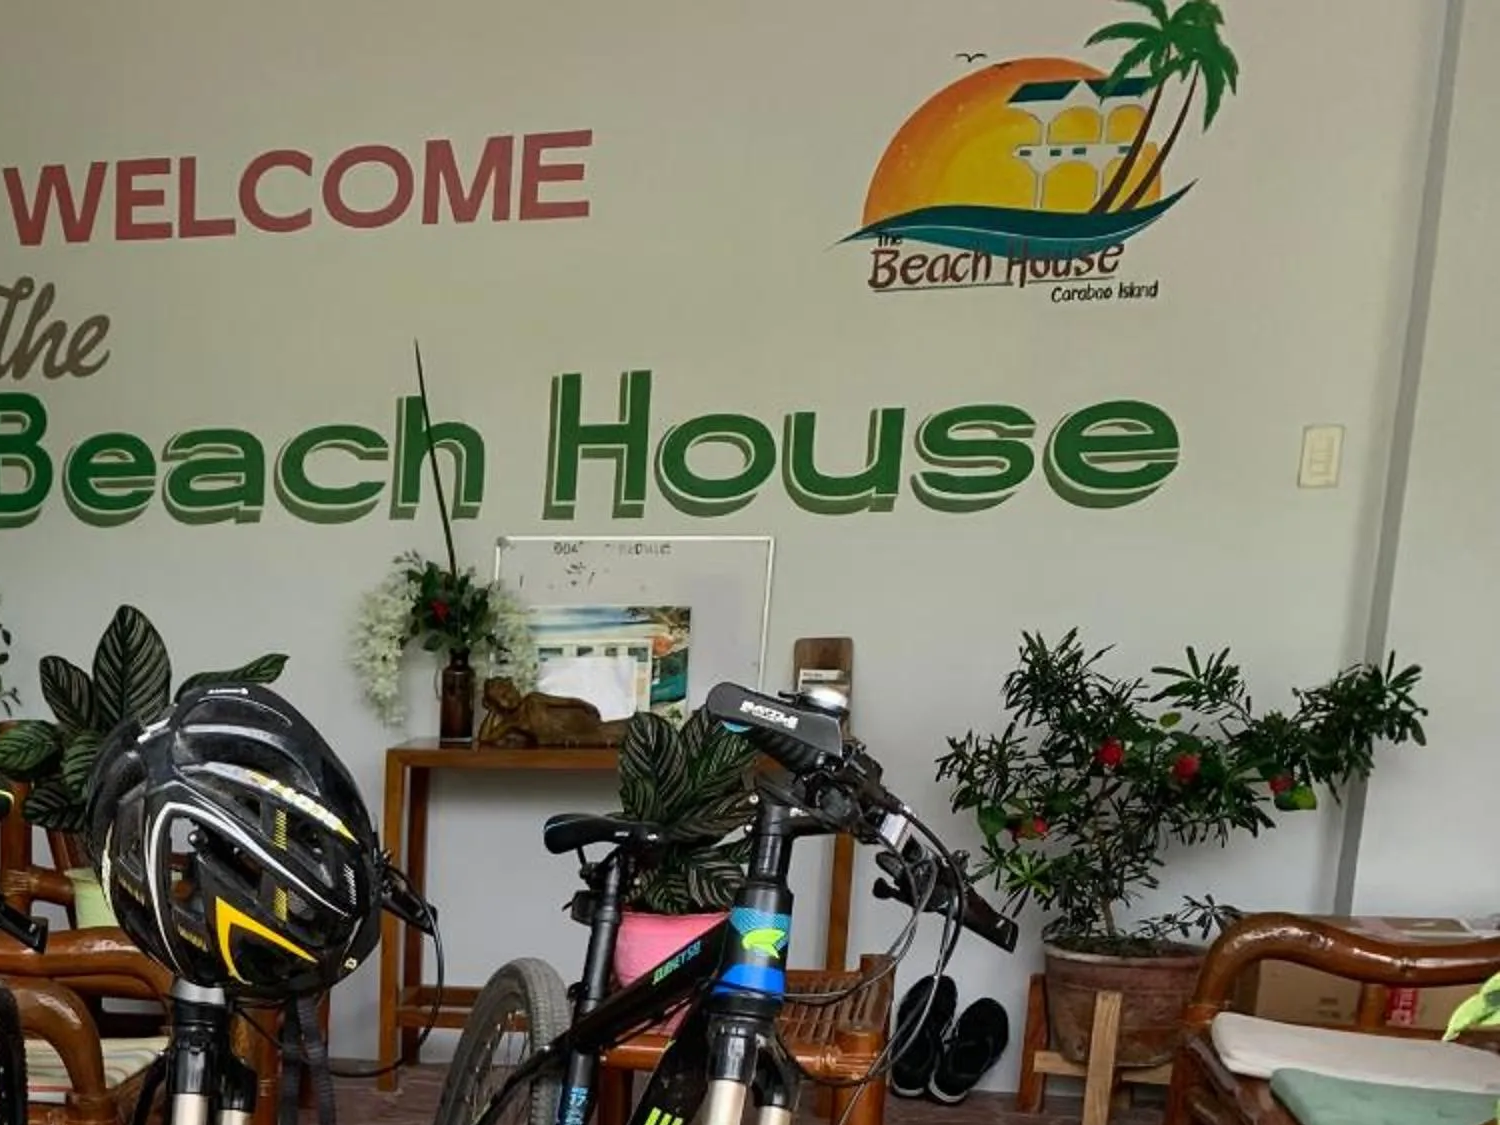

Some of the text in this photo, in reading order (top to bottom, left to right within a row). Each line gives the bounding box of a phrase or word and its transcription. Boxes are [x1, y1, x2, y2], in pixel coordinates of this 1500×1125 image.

[3, 129, 594, 247] WELCOME
[868, 236, 1125, 290] Beach House
[1051, 280, 1160, 304] Carabao Island
[542, 369, 1181, 521] House
